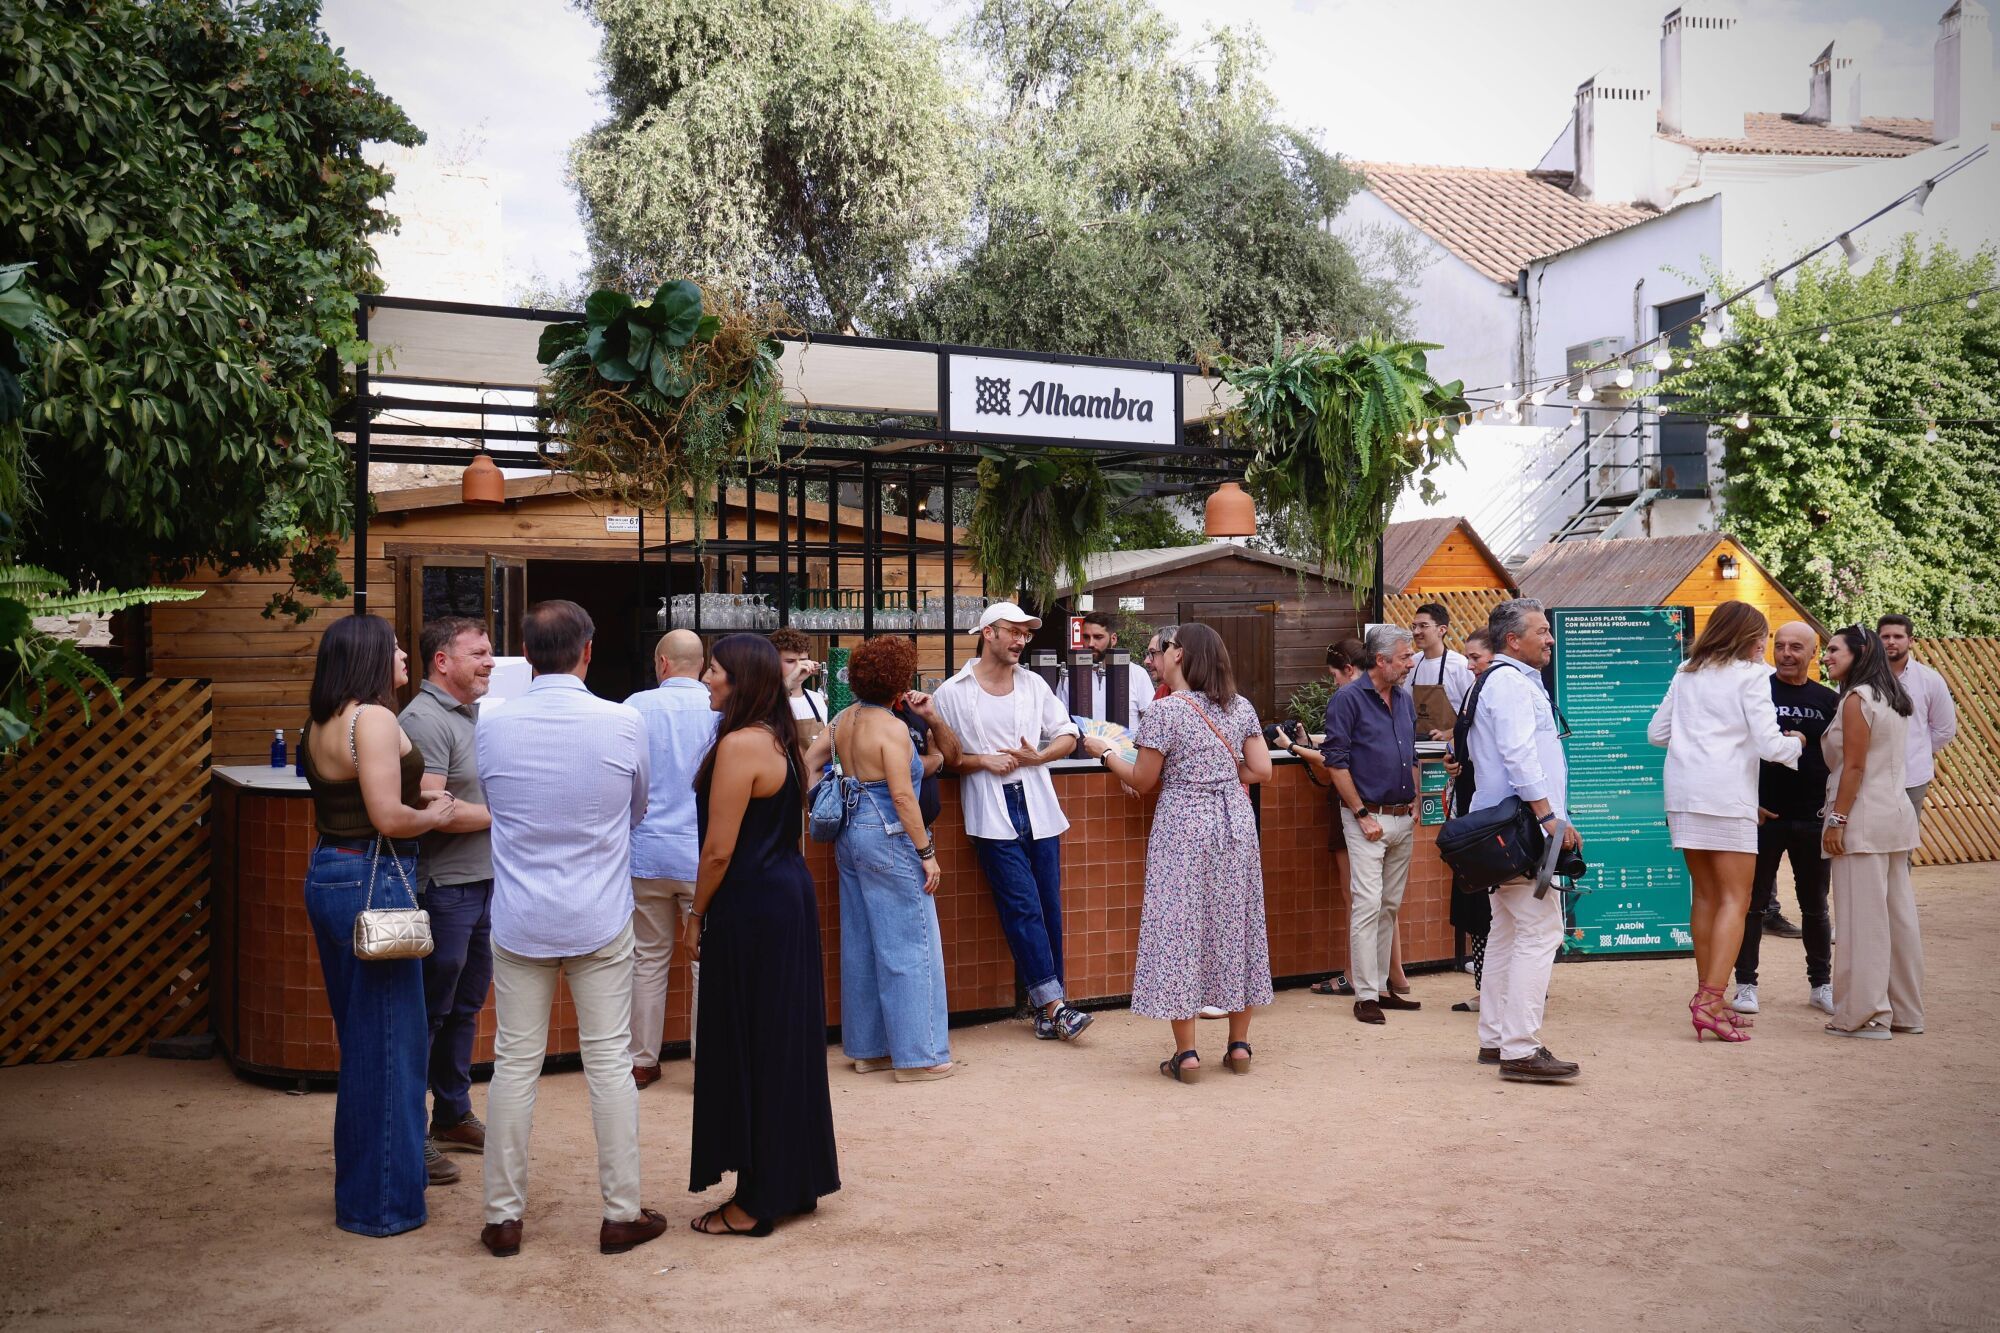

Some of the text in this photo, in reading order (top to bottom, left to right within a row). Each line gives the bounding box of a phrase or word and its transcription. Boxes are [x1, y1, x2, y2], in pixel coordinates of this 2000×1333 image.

[1017, 380, 1154, 422] Alhambra
[1615, 921, 1645, 930] JARDÍN
[1613, 933, 1661, 946] Alhambra
